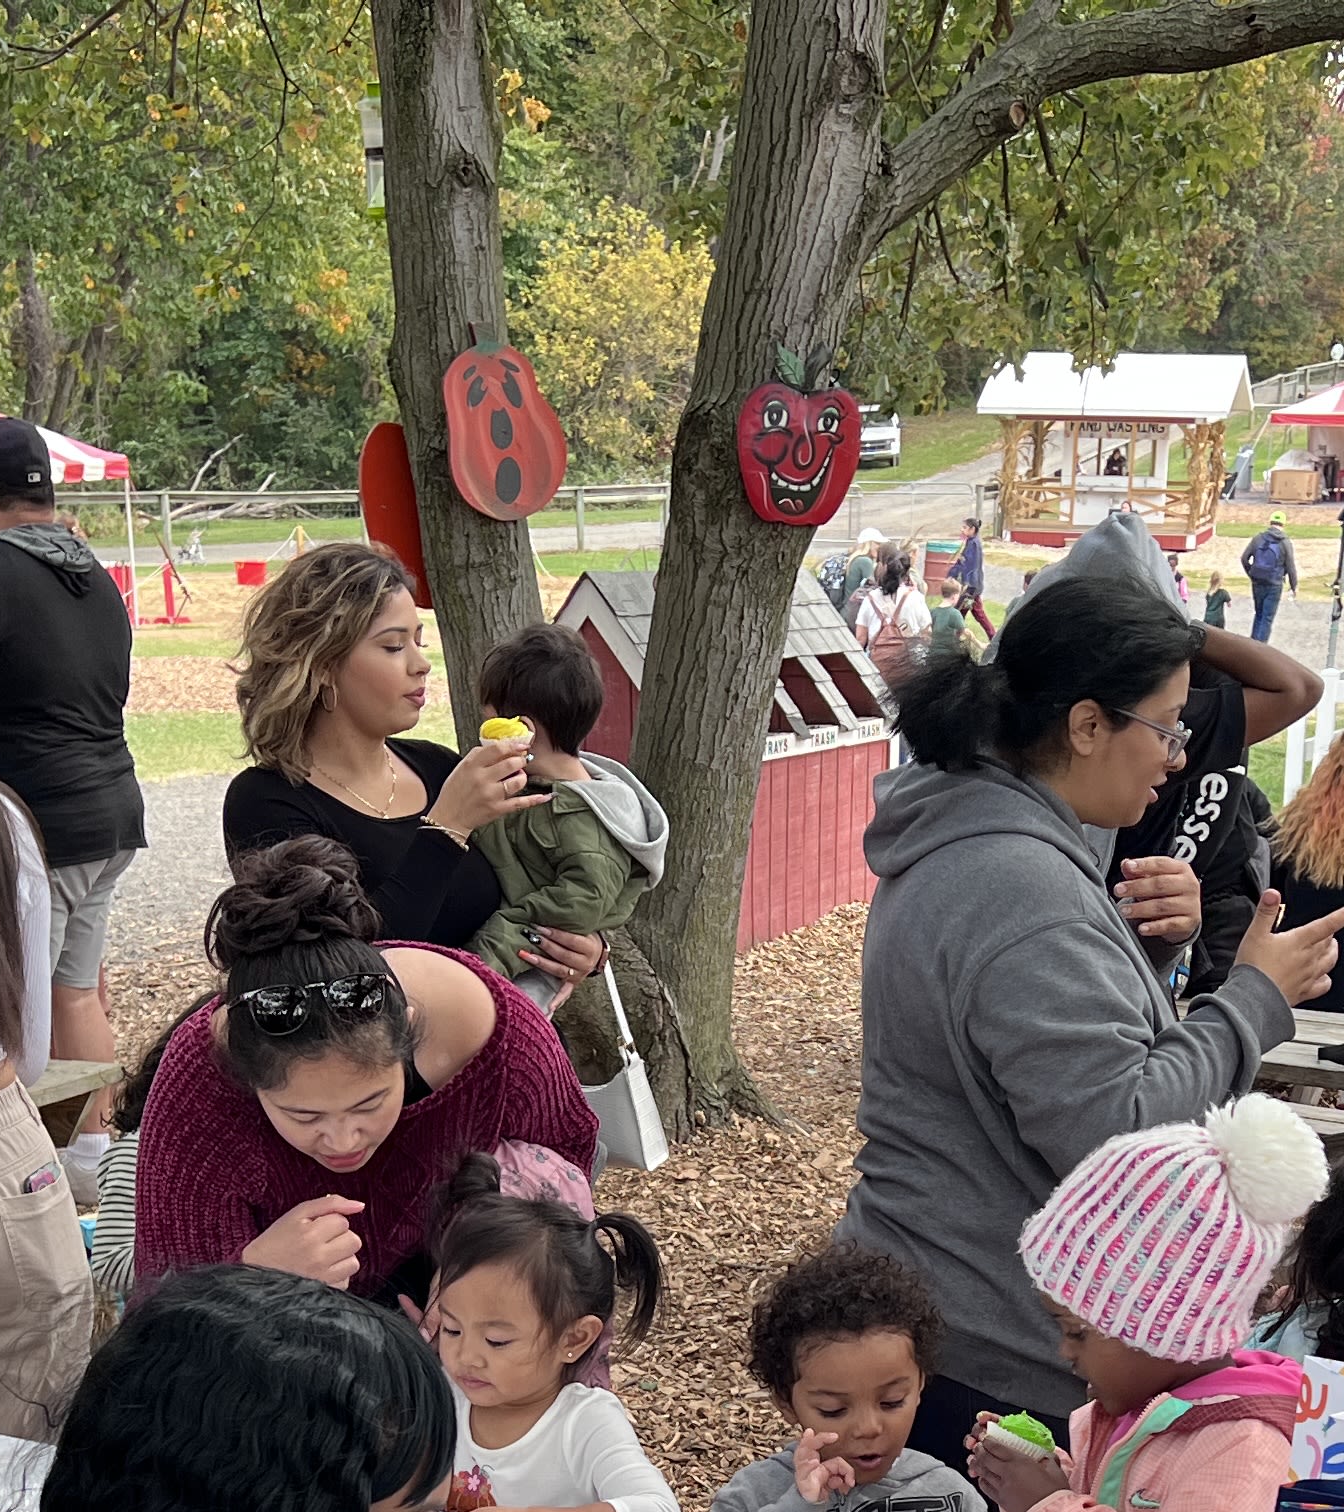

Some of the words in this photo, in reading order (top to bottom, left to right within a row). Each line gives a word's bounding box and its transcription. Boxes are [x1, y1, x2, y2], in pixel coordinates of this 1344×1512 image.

[811, 730, 836, 748] TRASH
[858, 723, 881, 740] TRASH
[765, 738, 788, 756] RAYS
